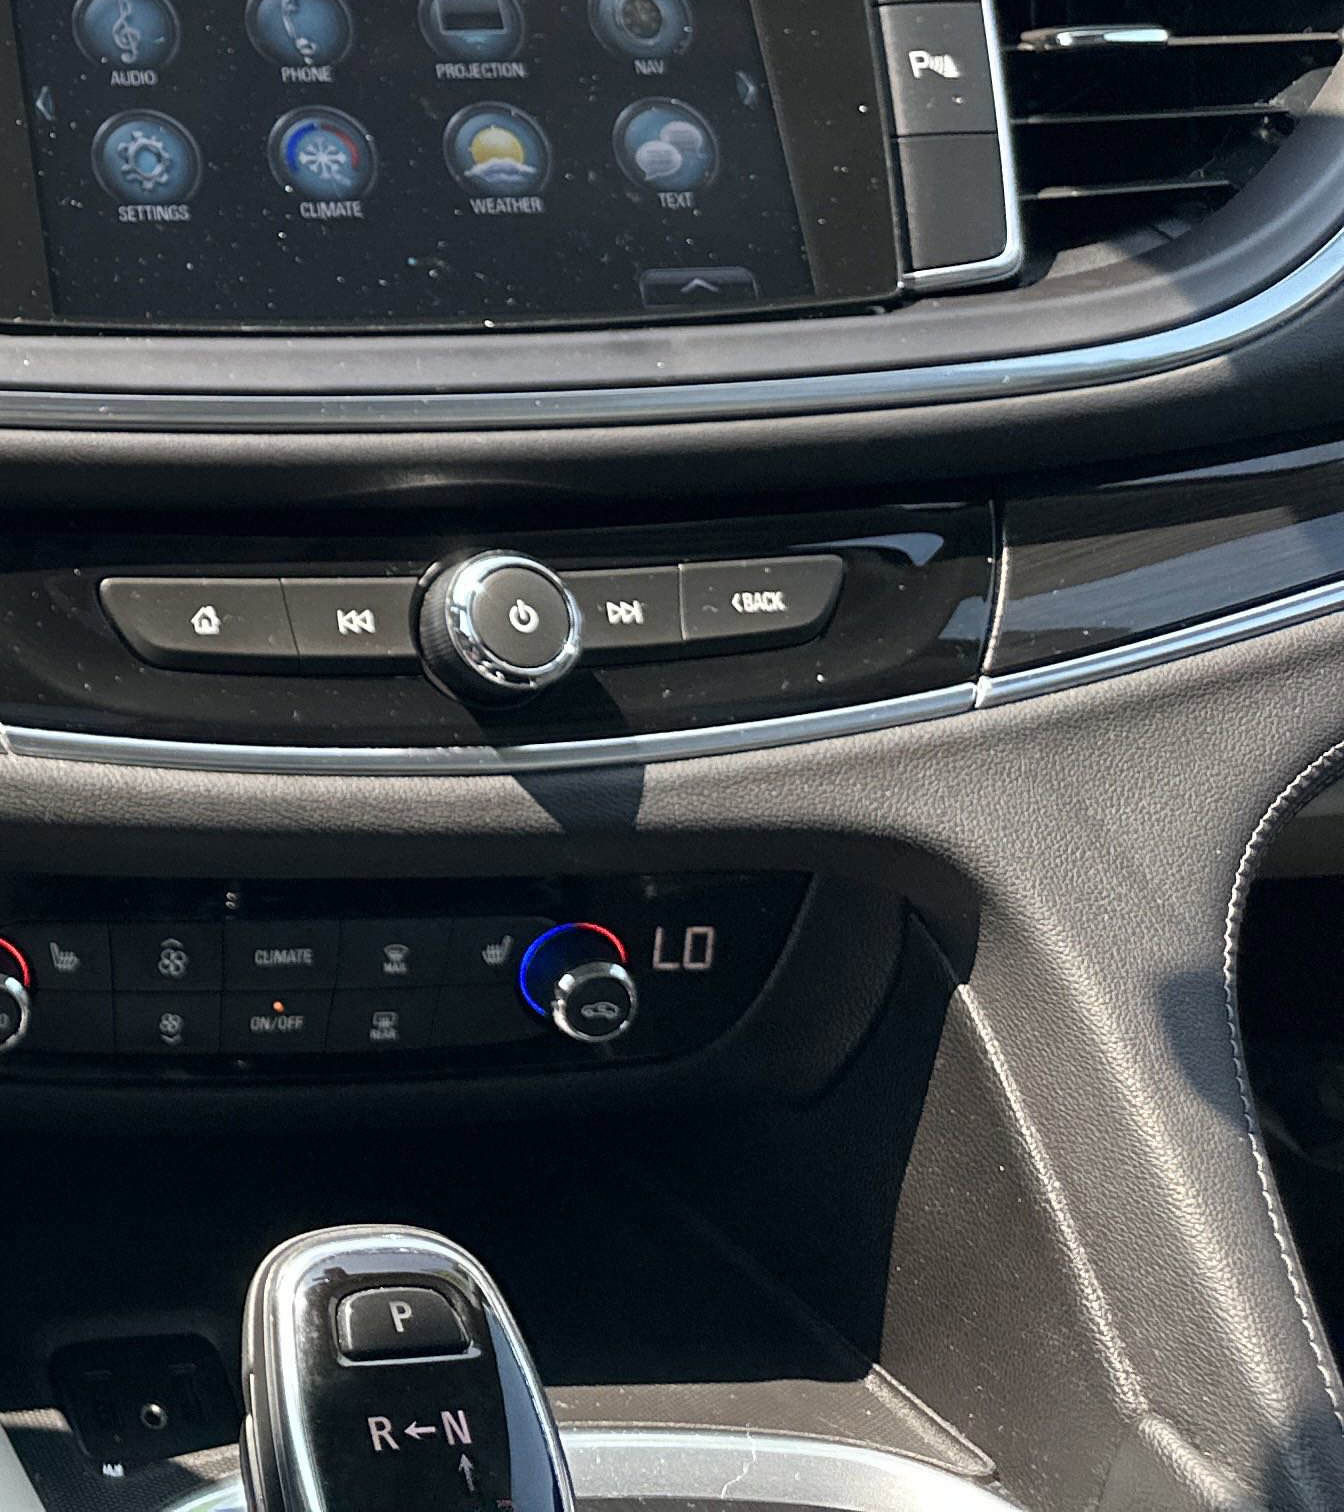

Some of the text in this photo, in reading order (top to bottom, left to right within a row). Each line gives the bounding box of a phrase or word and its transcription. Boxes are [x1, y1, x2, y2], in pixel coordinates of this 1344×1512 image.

[281, 66, 332, 82] PHONE
[436, 62, 524, 78] PROJECTION
[635, 59, 664, 75] NAV
[111, 70, 157, 86] AUDIO
[470, 196, 543, 214] WEATHER
[659, 192, 692, 209] TEXT
[118, 205, 190, 222] SETTINGS
[300, 201, 363, 218] CLIMATE
[742, 591, 787, 613] BACK
[653, 926, 714, 969] LO
[254, 948, 313, 965] CLIMATE
[250, 1016, 304, 1031] ON/OFF
[389, 1301, 412, 1333] P
[367, 1410, 472, 1452] R N
